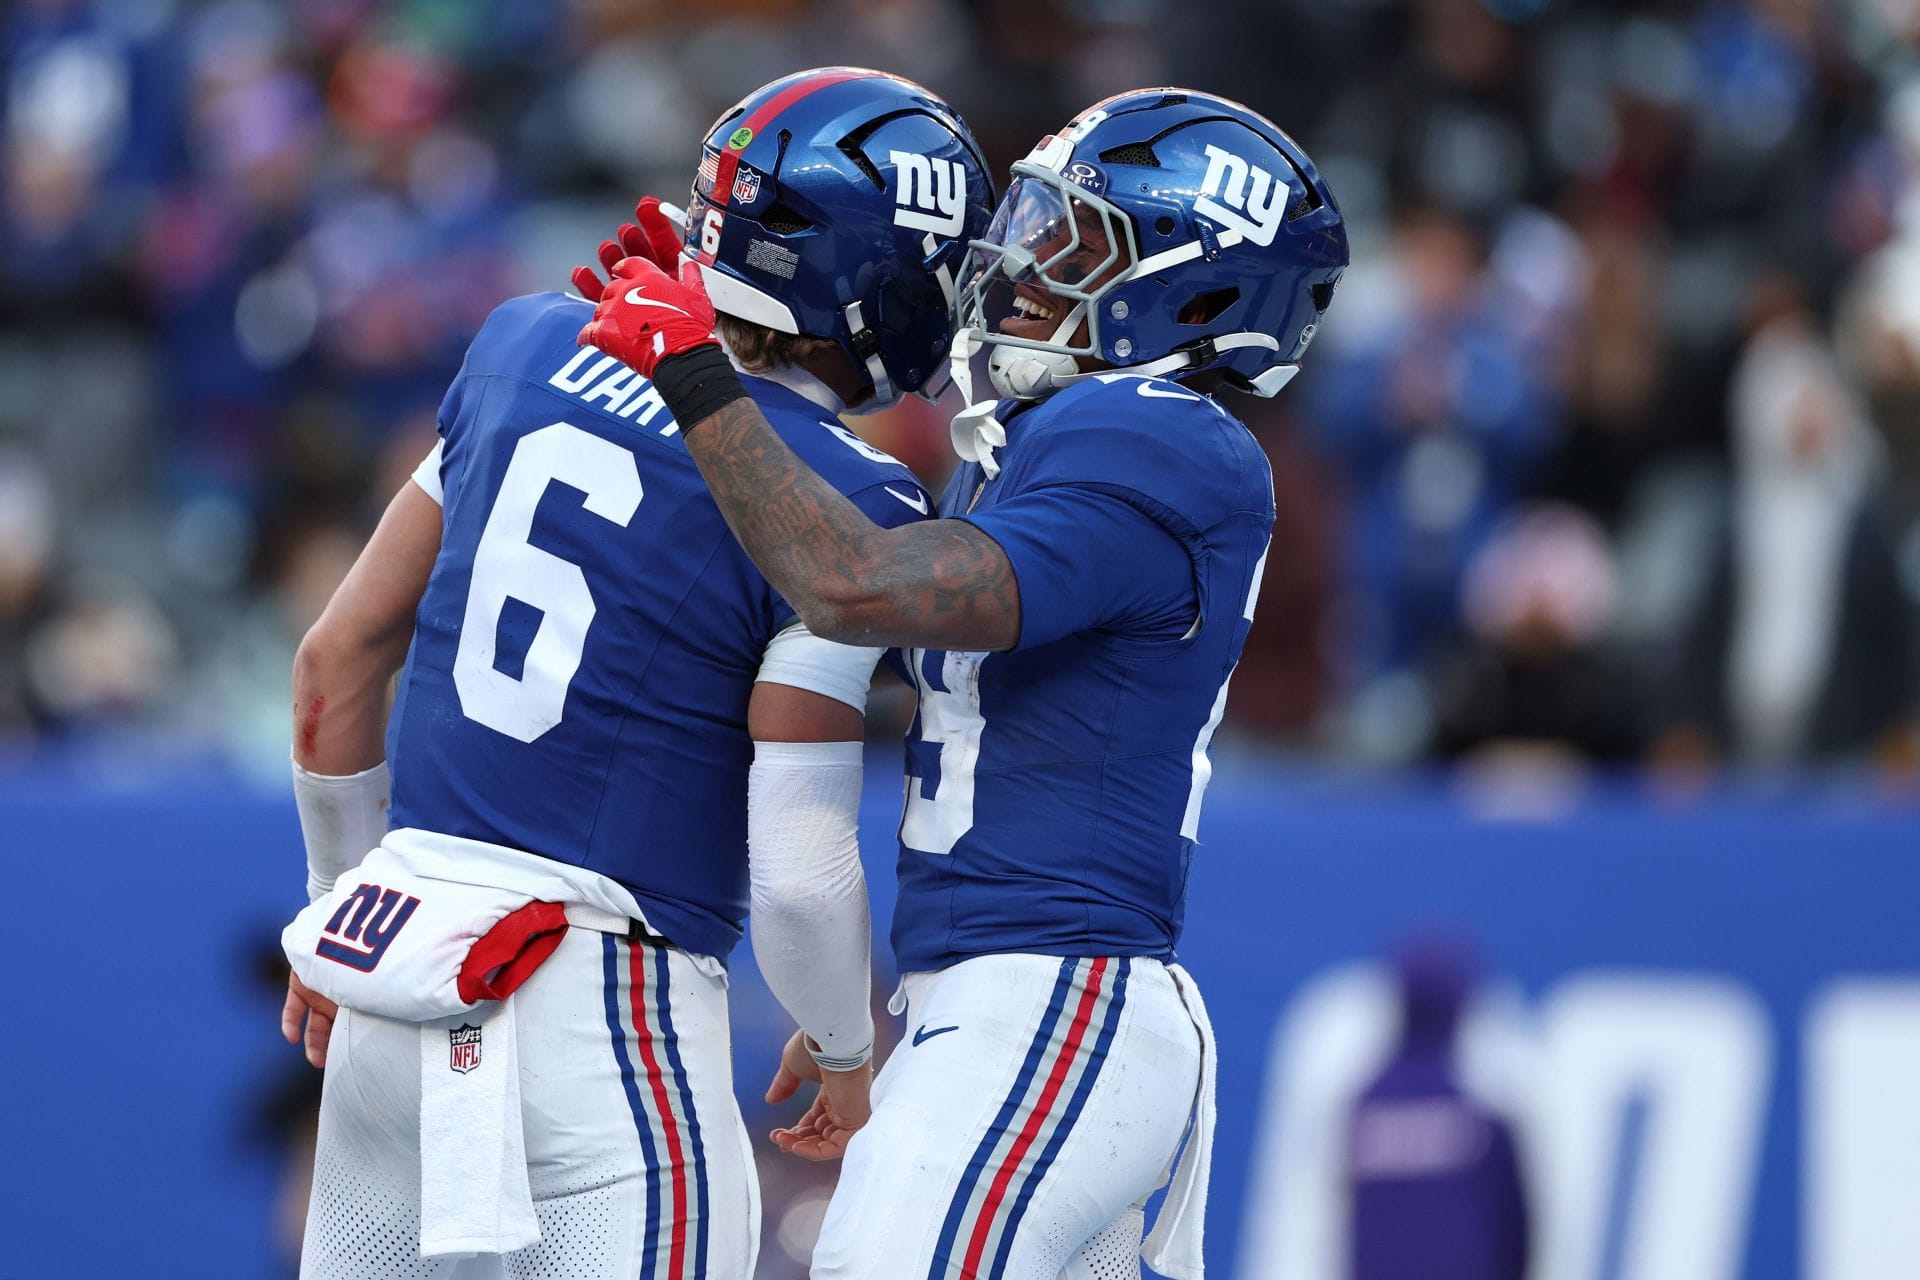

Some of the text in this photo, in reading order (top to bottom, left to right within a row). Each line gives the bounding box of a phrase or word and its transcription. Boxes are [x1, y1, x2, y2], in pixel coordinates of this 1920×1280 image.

[736, 181, 753, 199] NFL
[702, 209, 724, 255] 6
[548, 345, 680, 437] DAR
[453, 422, 644, 743] 6
[453, 1043, 479, 1068] NFL
